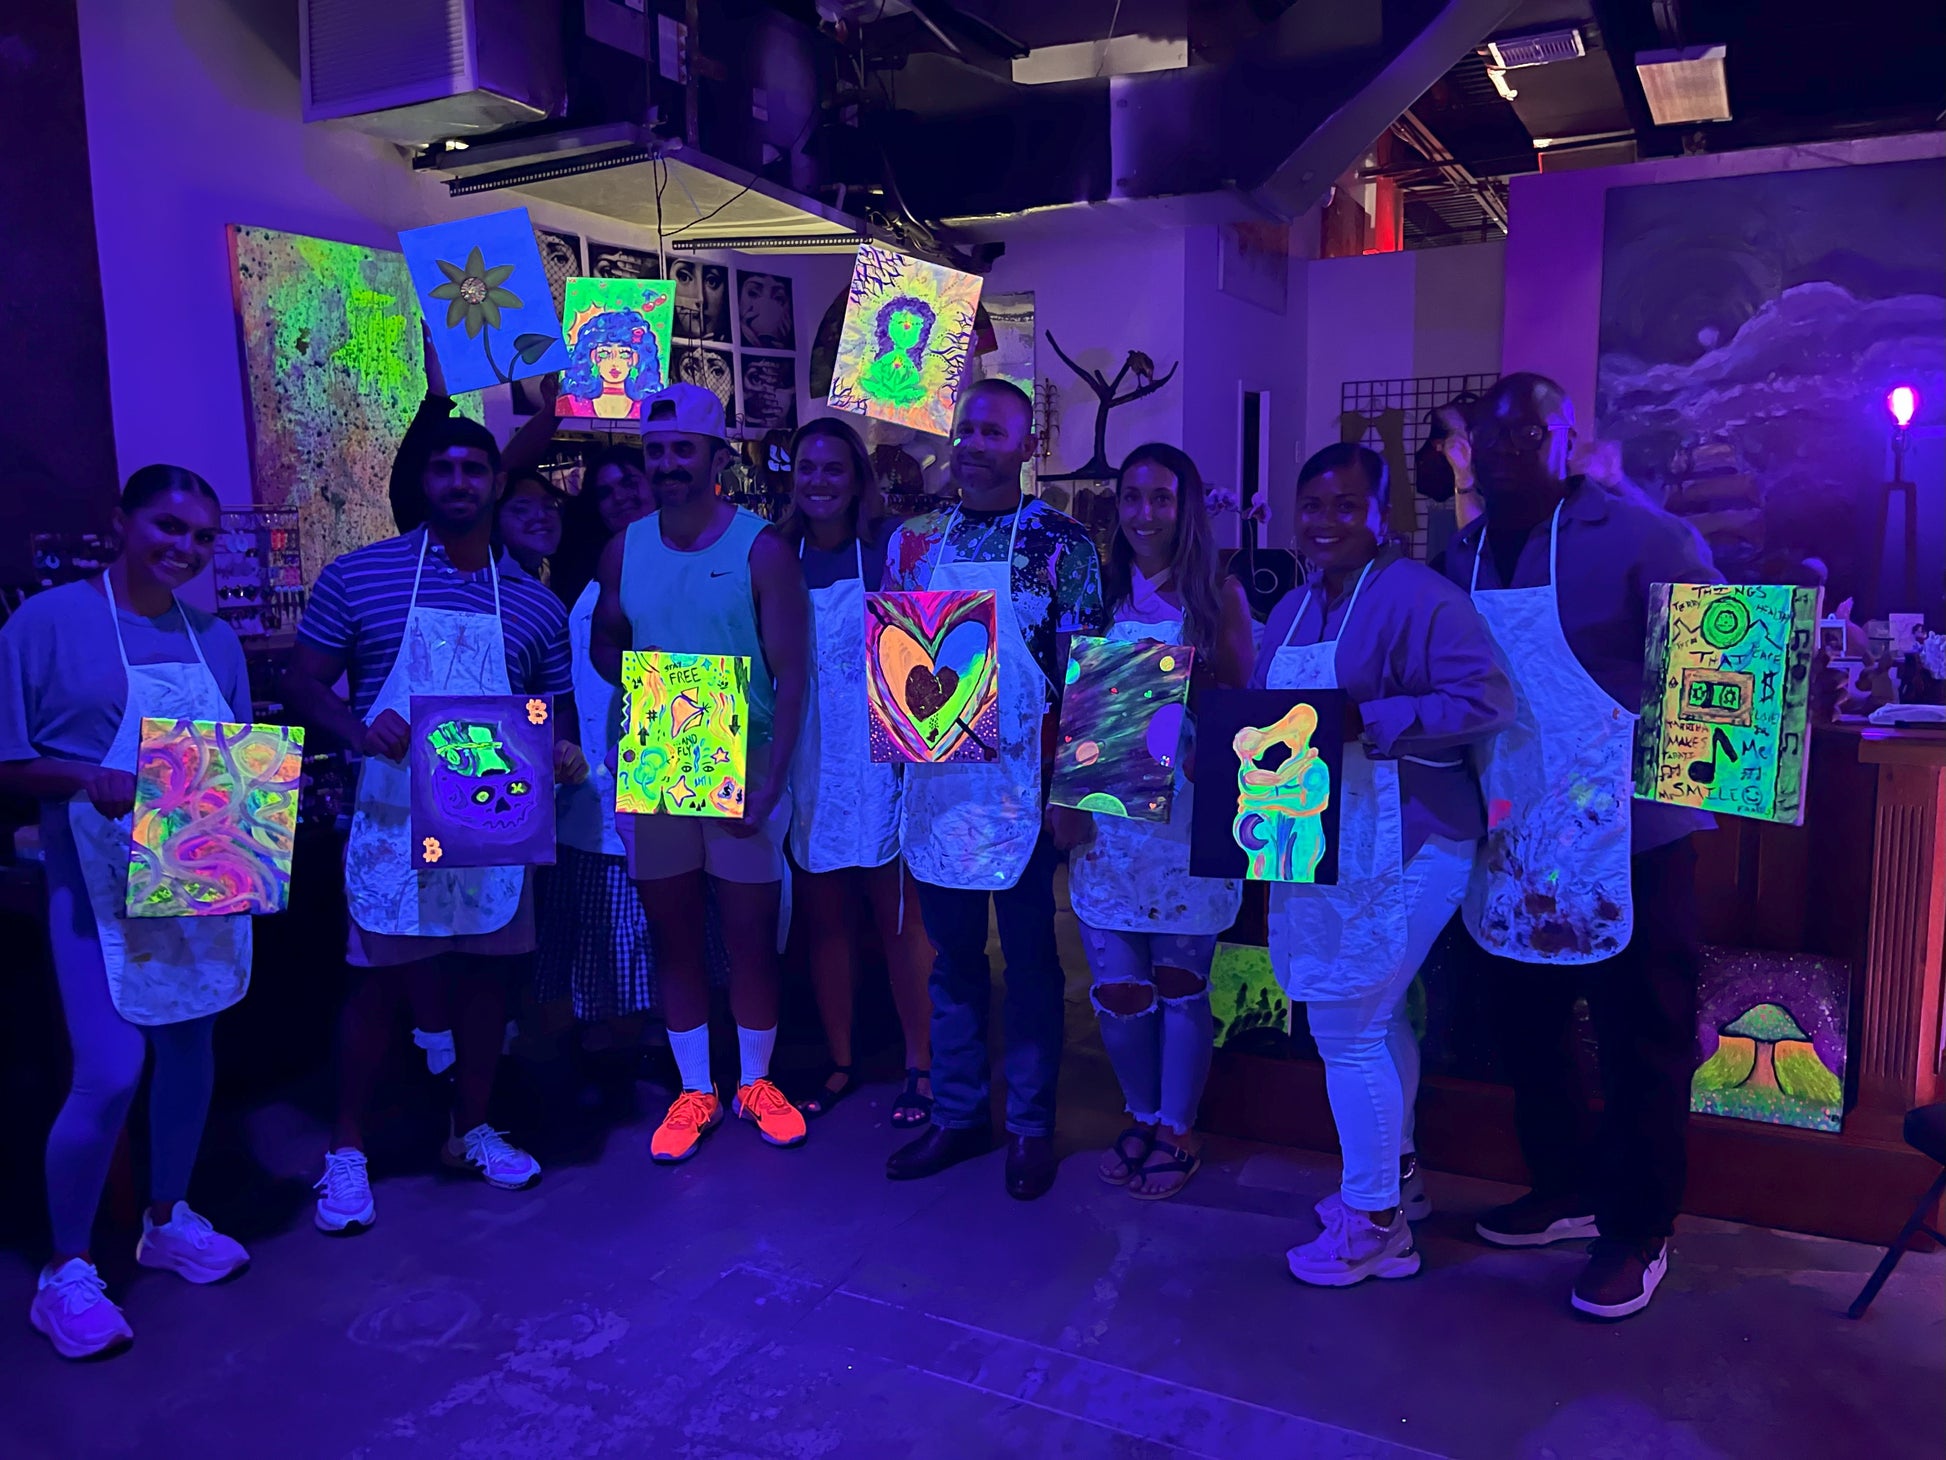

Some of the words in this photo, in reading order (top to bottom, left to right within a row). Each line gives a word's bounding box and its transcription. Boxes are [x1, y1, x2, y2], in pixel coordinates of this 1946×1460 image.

[1691, 585, 1766, 598] THINGS
[1689, 651, 1746, 668] THAT
[664, 661, 682, 673] STAY
[669, 667, 701, 685] FREE
[632, 676, 643, 690] 24
[1667, 735, 1708, 748] MAKES
[677, 745, 692, 756] FLY
[1671, 782, 1739, 802] SMILE
